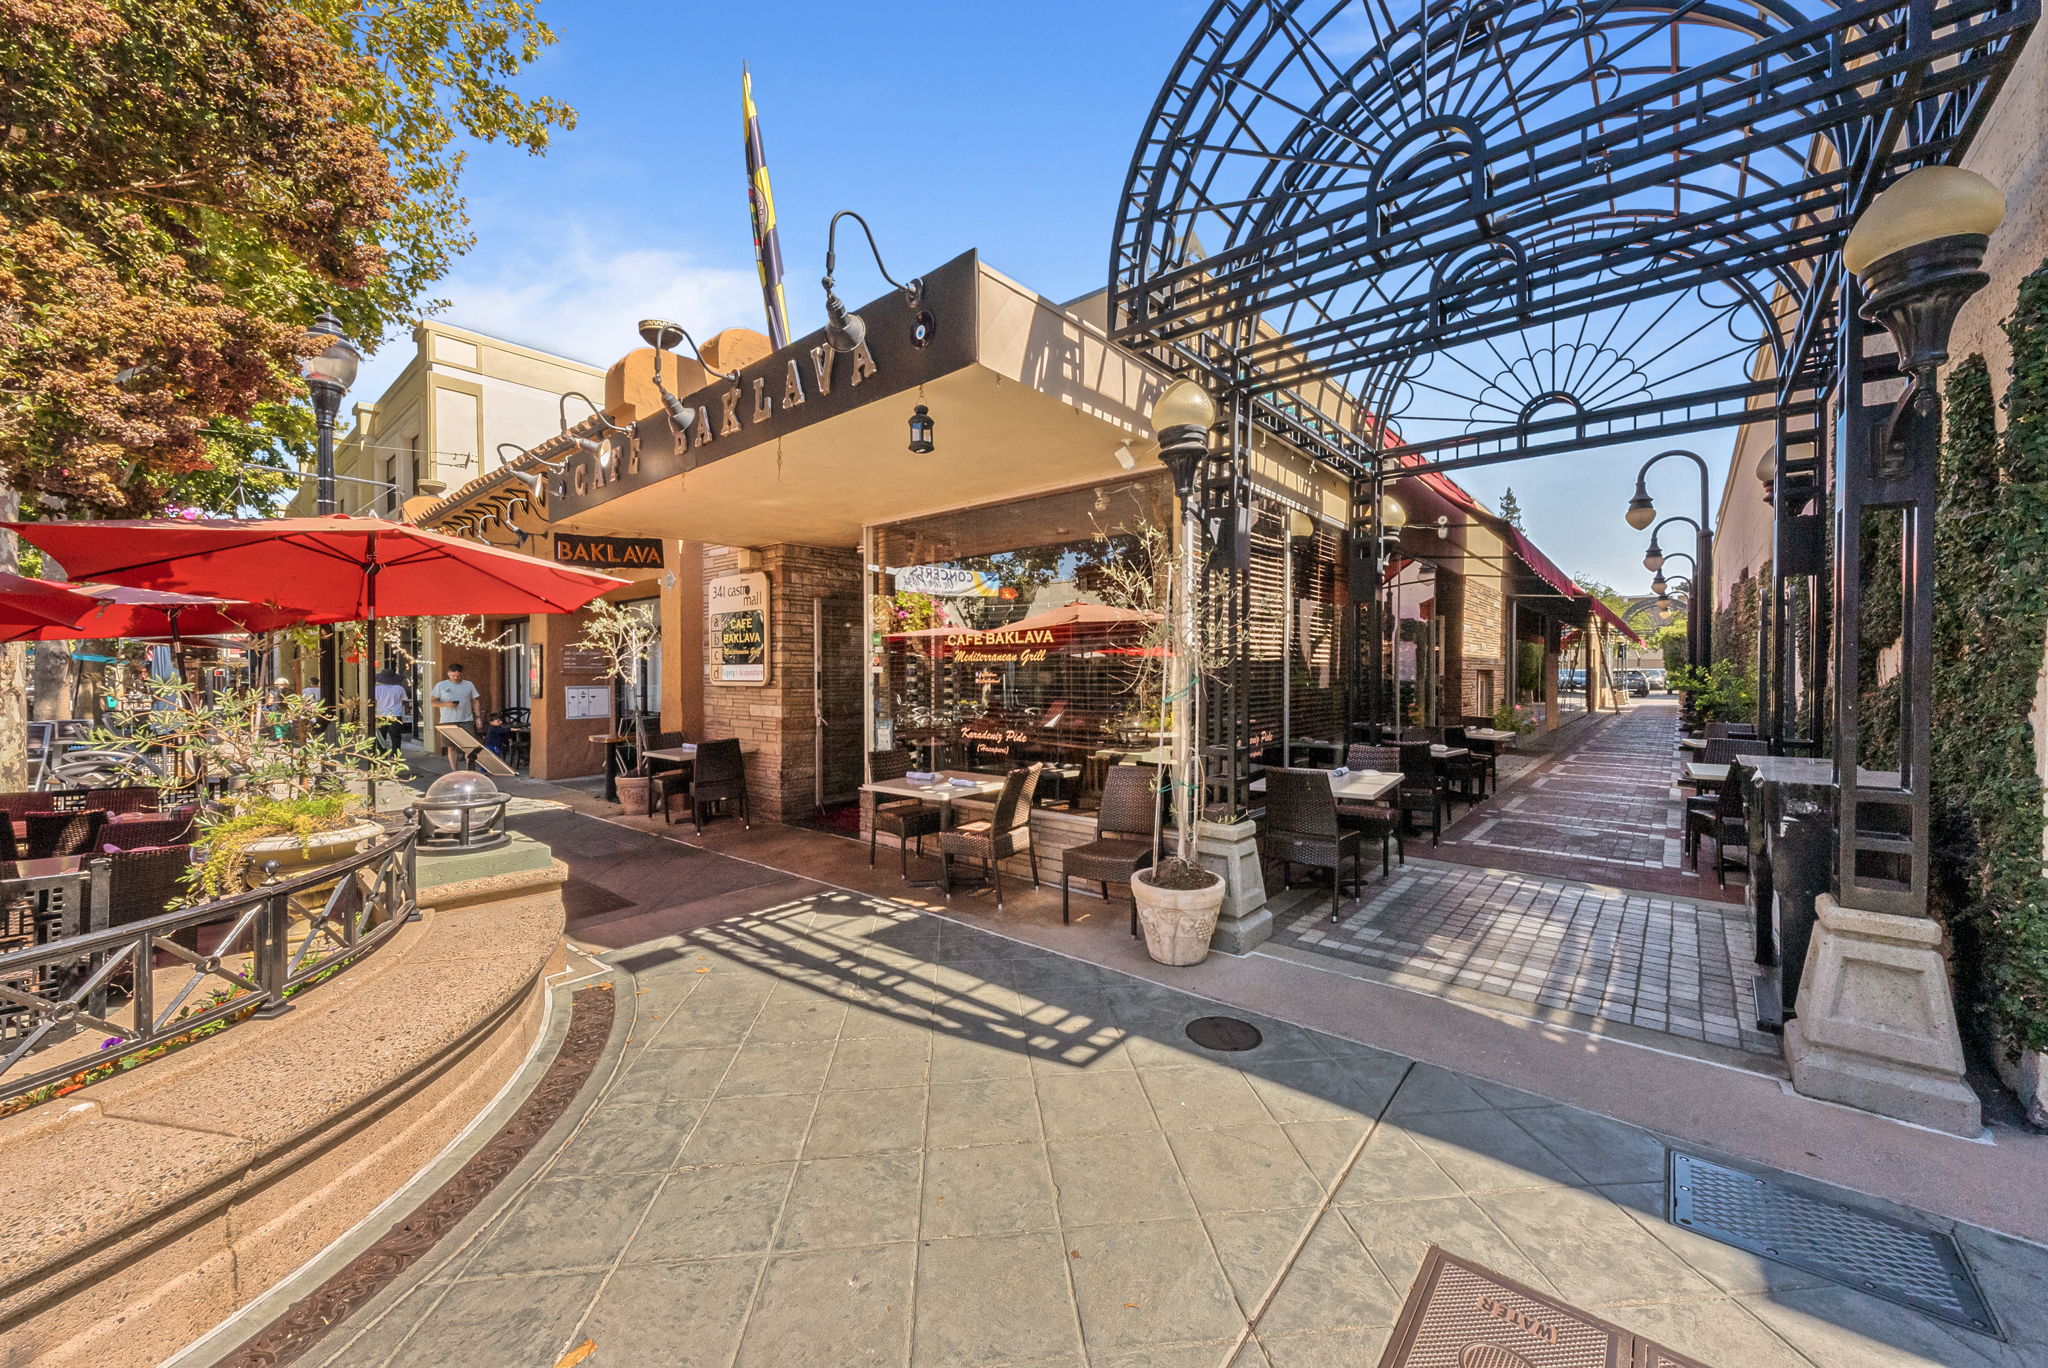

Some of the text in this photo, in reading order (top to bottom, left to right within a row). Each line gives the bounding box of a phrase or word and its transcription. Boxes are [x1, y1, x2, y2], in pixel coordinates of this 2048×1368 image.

[575, 436, 641, 496] CAFE
[557, 540, 662, 564] BAKLAVA
[712, 586, 726, 600] 341
[743, 590, 762, 606] mall
[730, 617, 753, 629] CAFE
[723, 632, 761, 644] BAKLAVA
[947, 630, 1055, 646] CAFE BAKLAVA
[954, 648, 1047, 667] Mediterranean Grill
[1005, 729, 1028, 743] Pide
[1480, 1297, 1555, 1341] WATER
